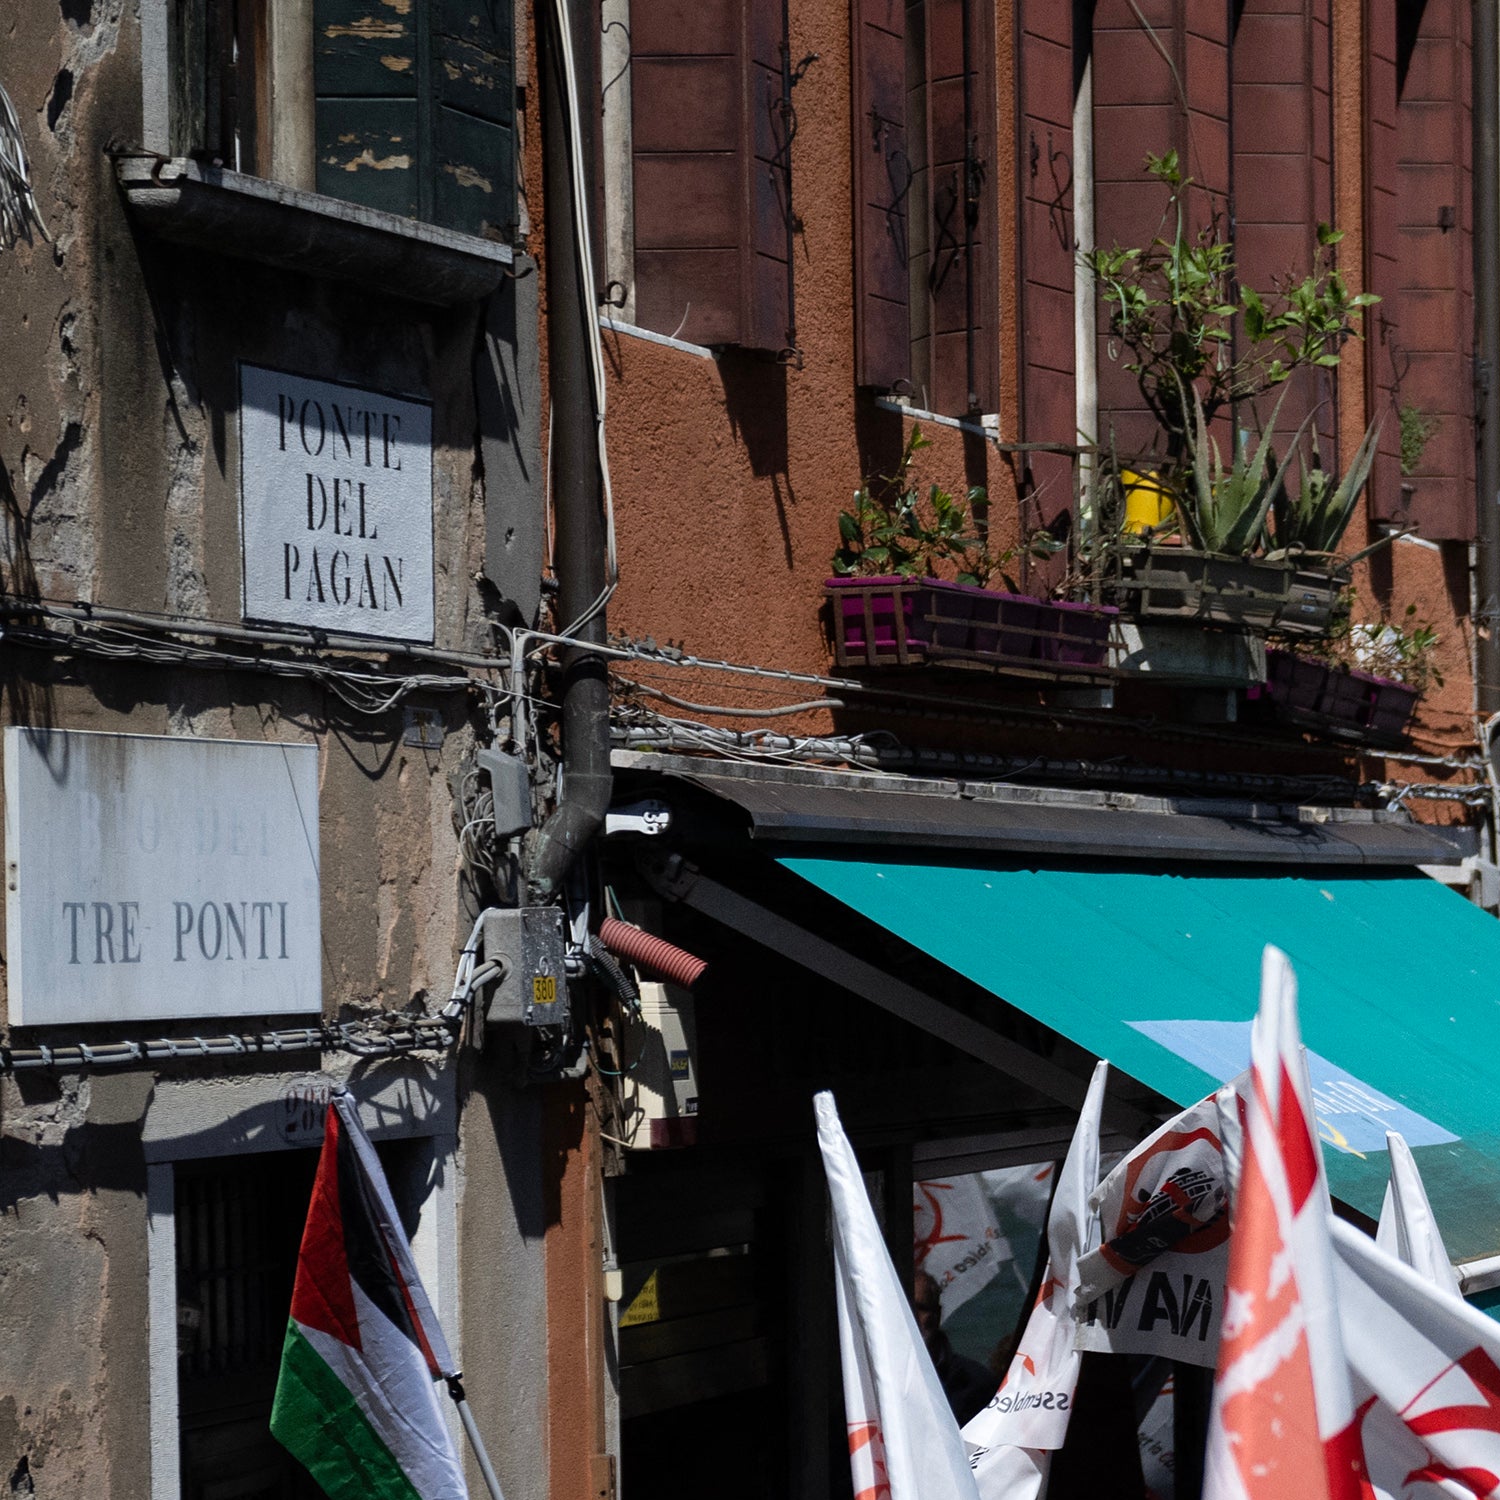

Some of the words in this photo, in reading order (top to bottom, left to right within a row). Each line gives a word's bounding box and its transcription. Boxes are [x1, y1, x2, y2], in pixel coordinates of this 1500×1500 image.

[278, 393, 401, 471] PONTE
[306, 473, 378, 539] DEL
[284, 543, 403, 611] PAGAN
[62, 902, 141, 964] TRE
[172, 900, 289, 962] PONTI
[535, 979, 554, 1001] 380
